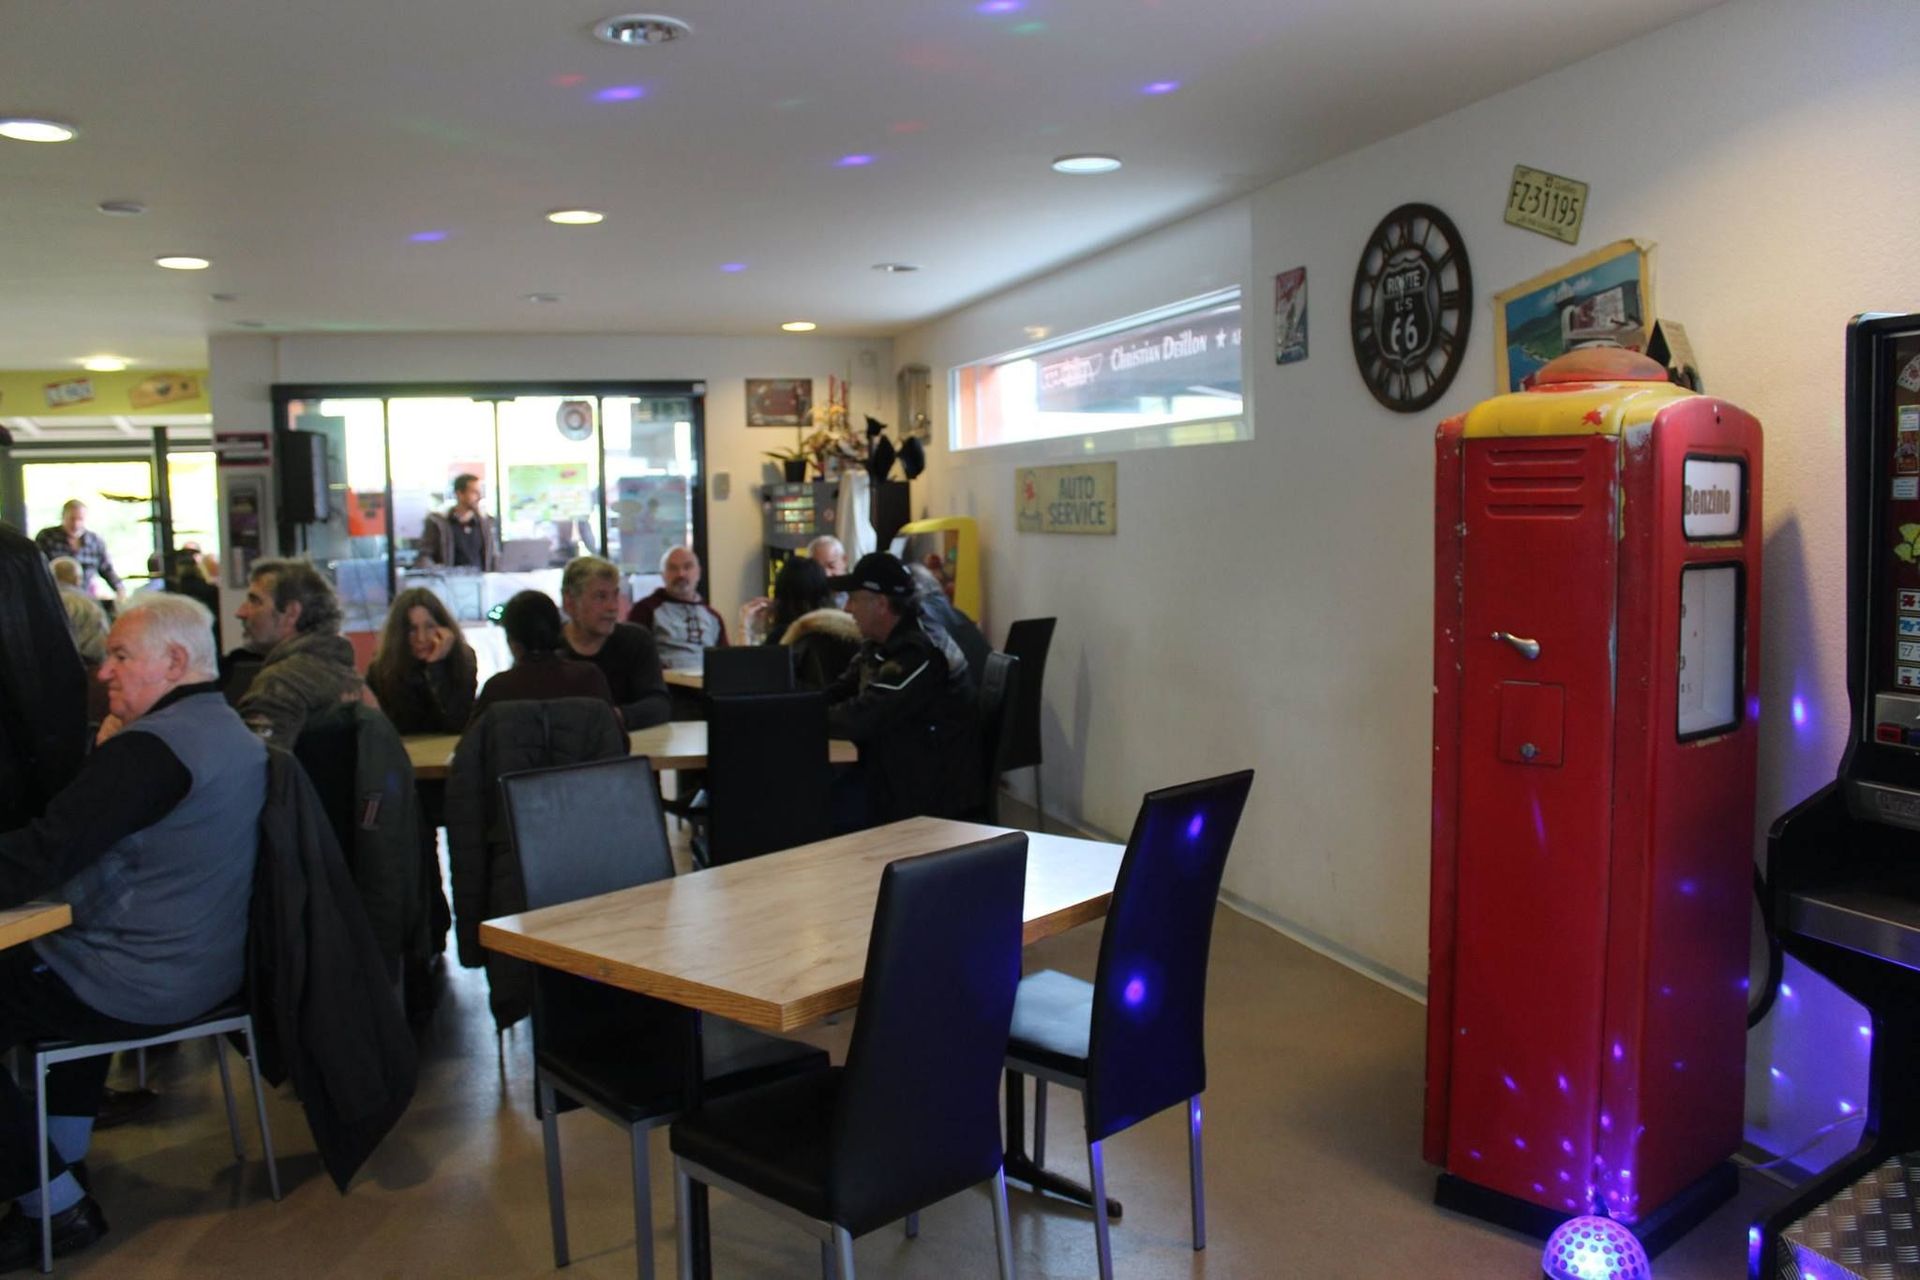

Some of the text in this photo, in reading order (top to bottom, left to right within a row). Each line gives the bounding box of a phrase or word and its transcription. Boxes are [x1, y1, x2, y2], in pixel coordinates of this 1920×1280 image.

[1386, 270, 1421, 293] ROUTE
[1390, 313, 1418, 352] 66
[1059, 475, 1095, 500] AUTO
[1685, 484, 1731, 516] Benzine
[1048, 500, 1106, 526] SERVICE
